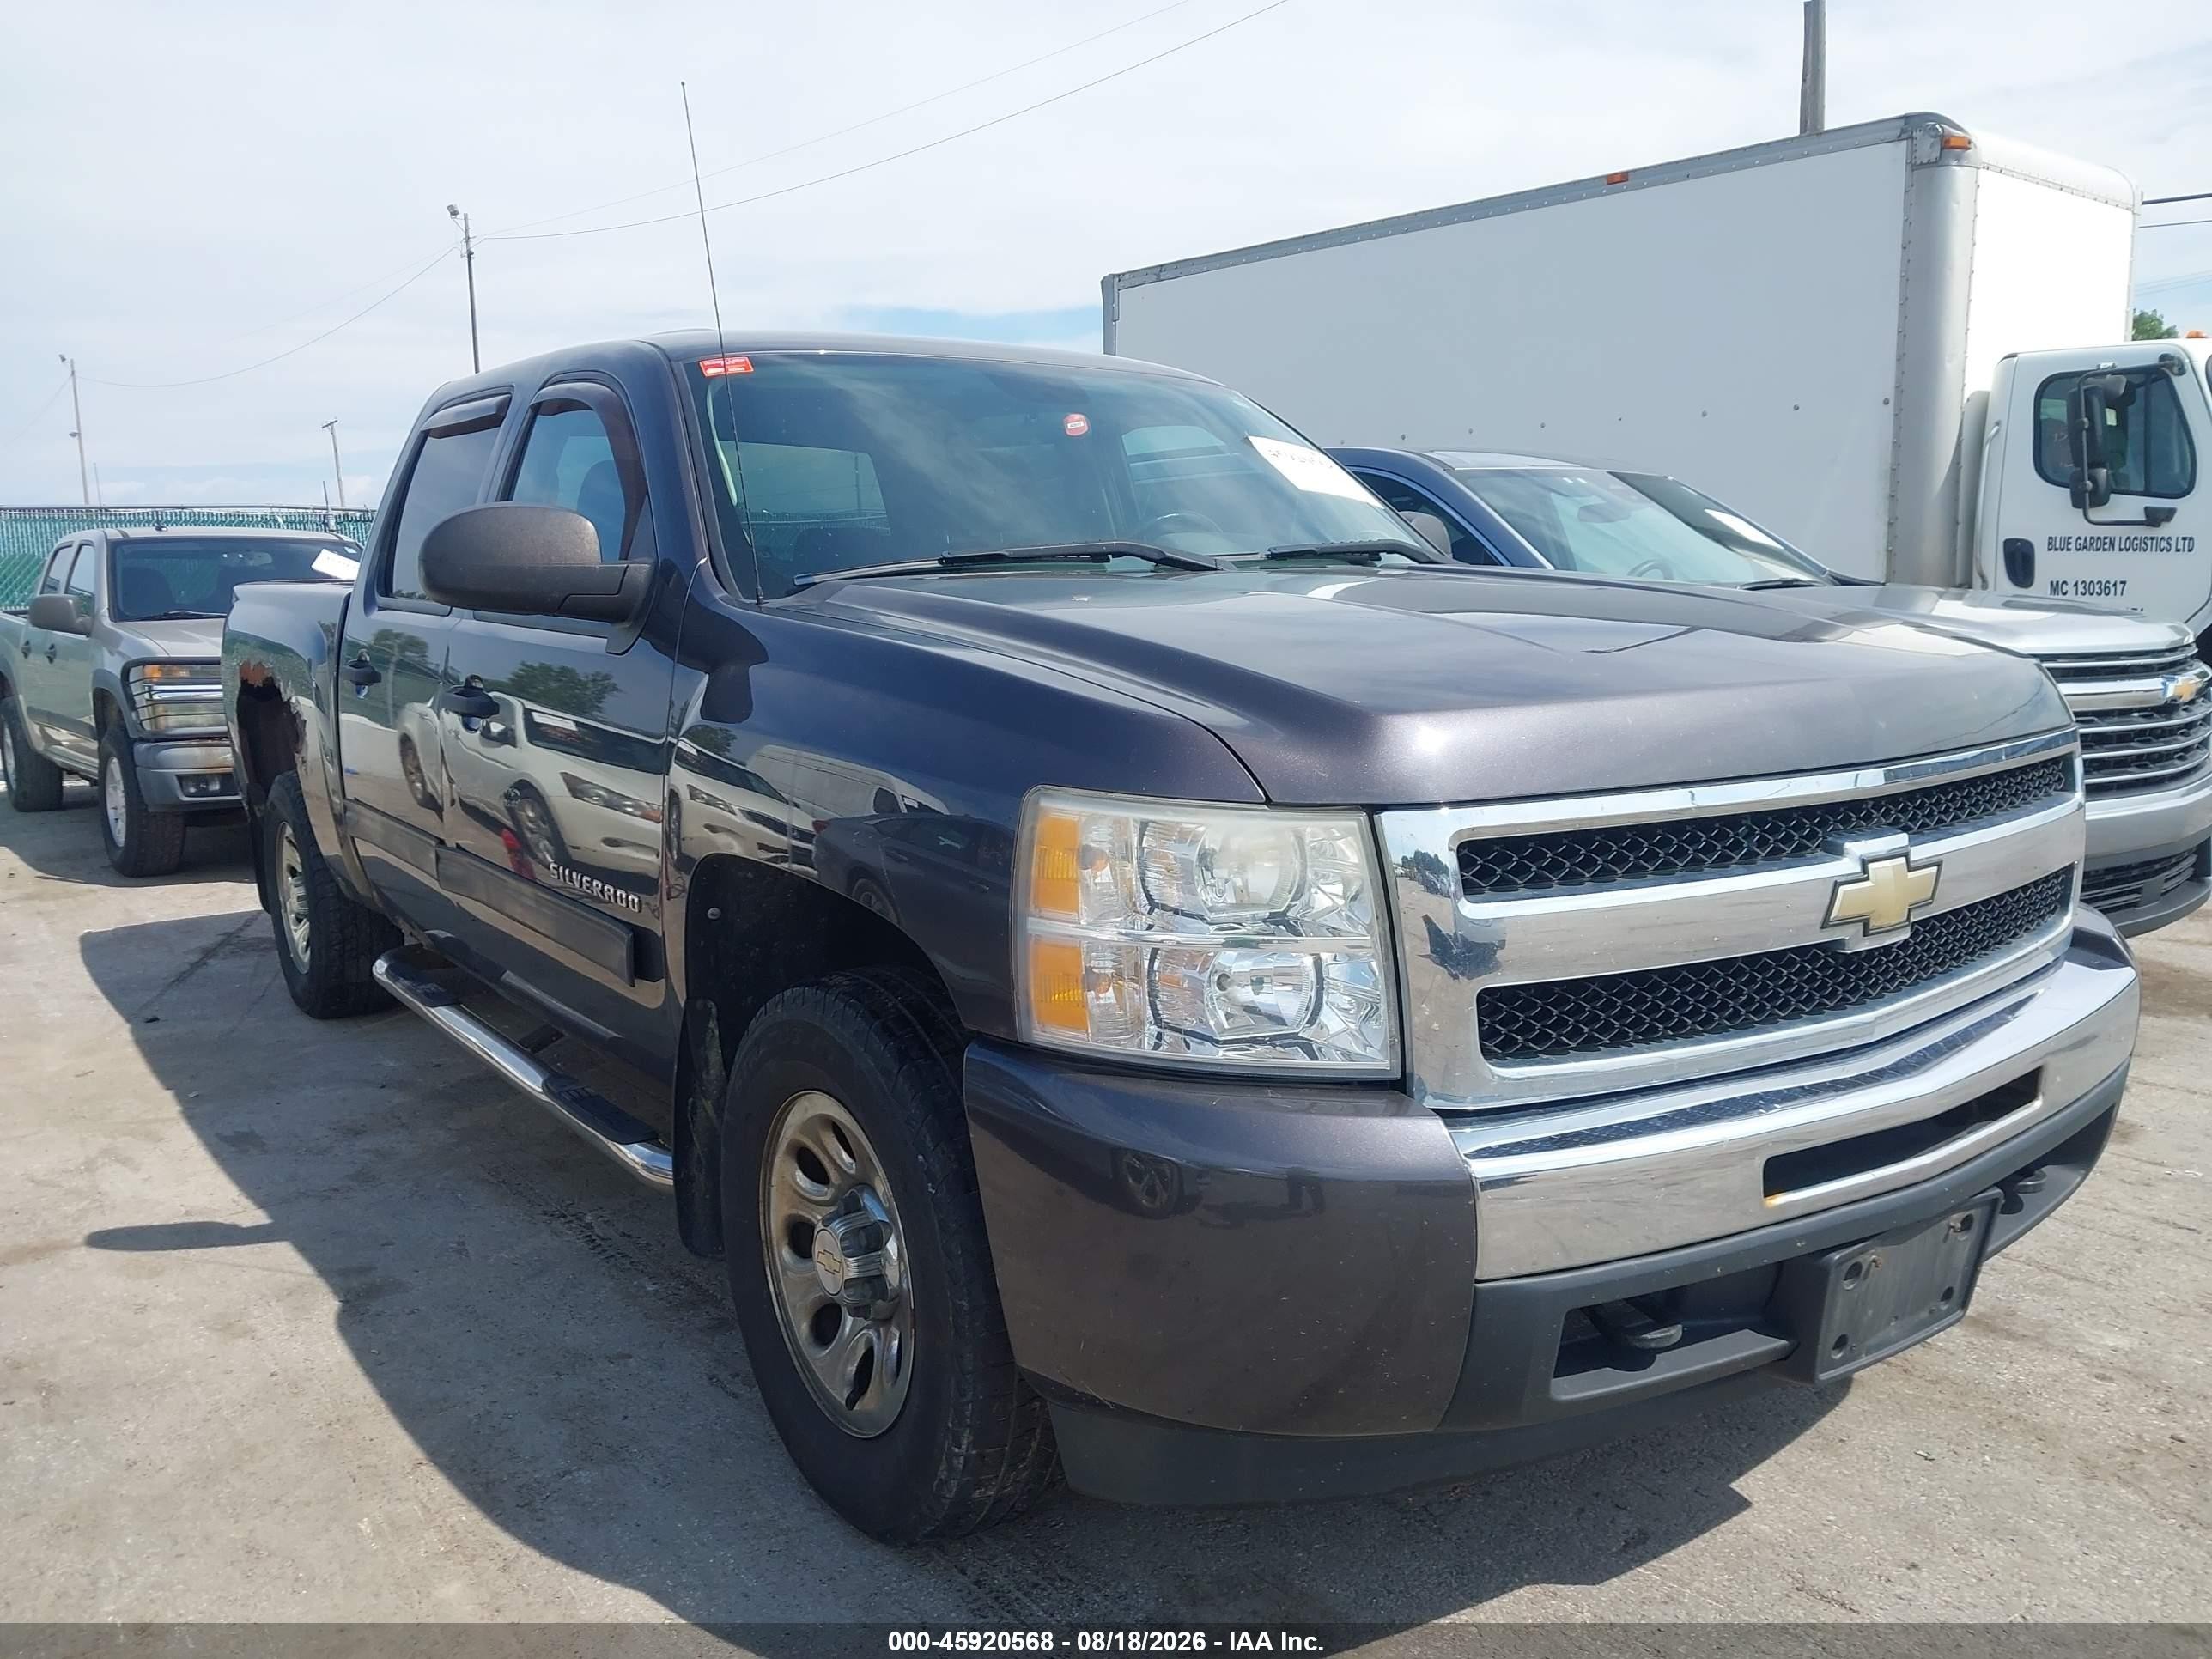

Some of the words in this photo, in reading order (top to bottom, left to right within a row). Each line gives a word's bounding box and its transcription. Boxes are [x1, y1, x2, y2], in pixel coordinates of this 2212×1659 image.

[2047, 536, 2072, 552] BLUE
[2075, 536, 2116, 552] GARDEN
[2118, 536, 2172, 553] LOGISTICS
[2174, 536, 2195, 553] LTD
[2050, 580, 2069, 596] MC
[2073, 580, 2127, 597] 1303617
[549, 862, 642, 913] SILVERADO
